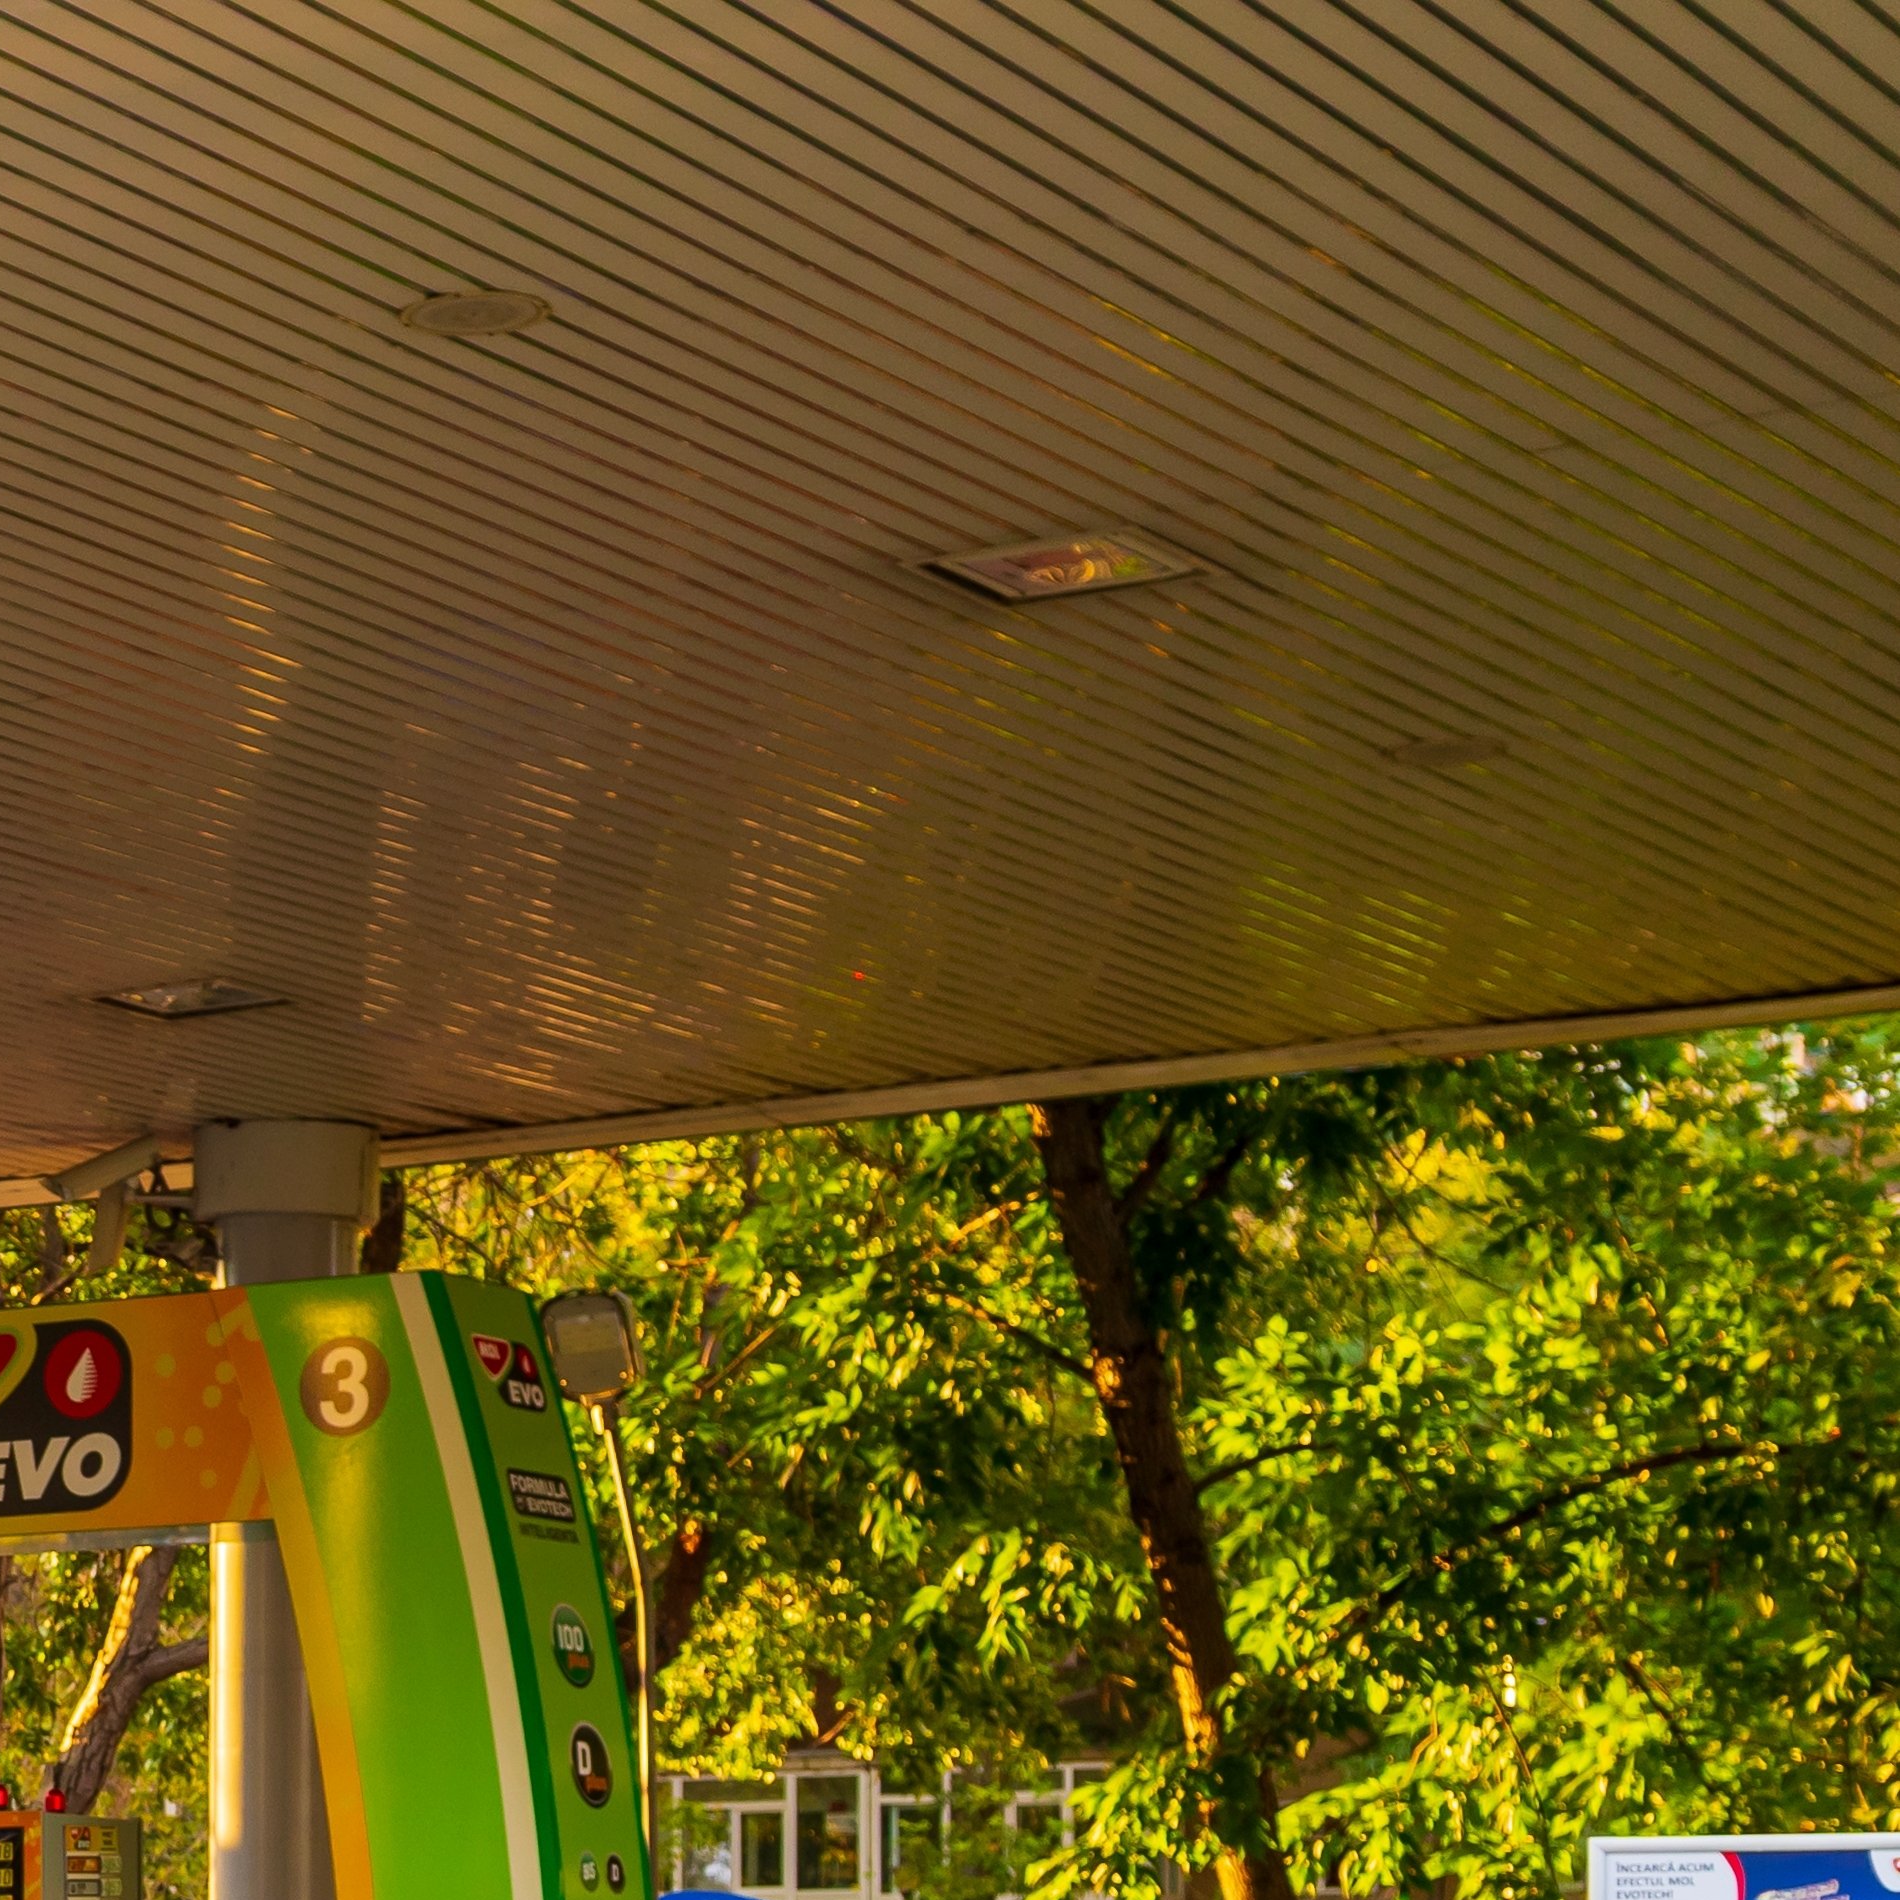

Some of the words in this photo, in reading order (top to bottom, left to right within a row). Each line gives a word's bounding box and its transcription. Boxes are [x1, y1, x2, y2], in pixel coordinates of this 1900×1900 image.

[319, 1346, 370, 1427] 3
[507, 1379, 544, 1409] EVO
[509, 1472, 570, 1500] FORMULA
[526, 1497, 573, 1519] EVOTECH
[556, 1625, 584, 1652] 100
[576, 1741, 591, 1775] D
[1616, 1861, 1676, 1874] ÎNCEARCĂ
[1678, 1863, 1715, 1873] ACUM
[1616, 1877, 1664, 1888] EFECTUL
[1668, 1877, 1695, 1887] MOL
